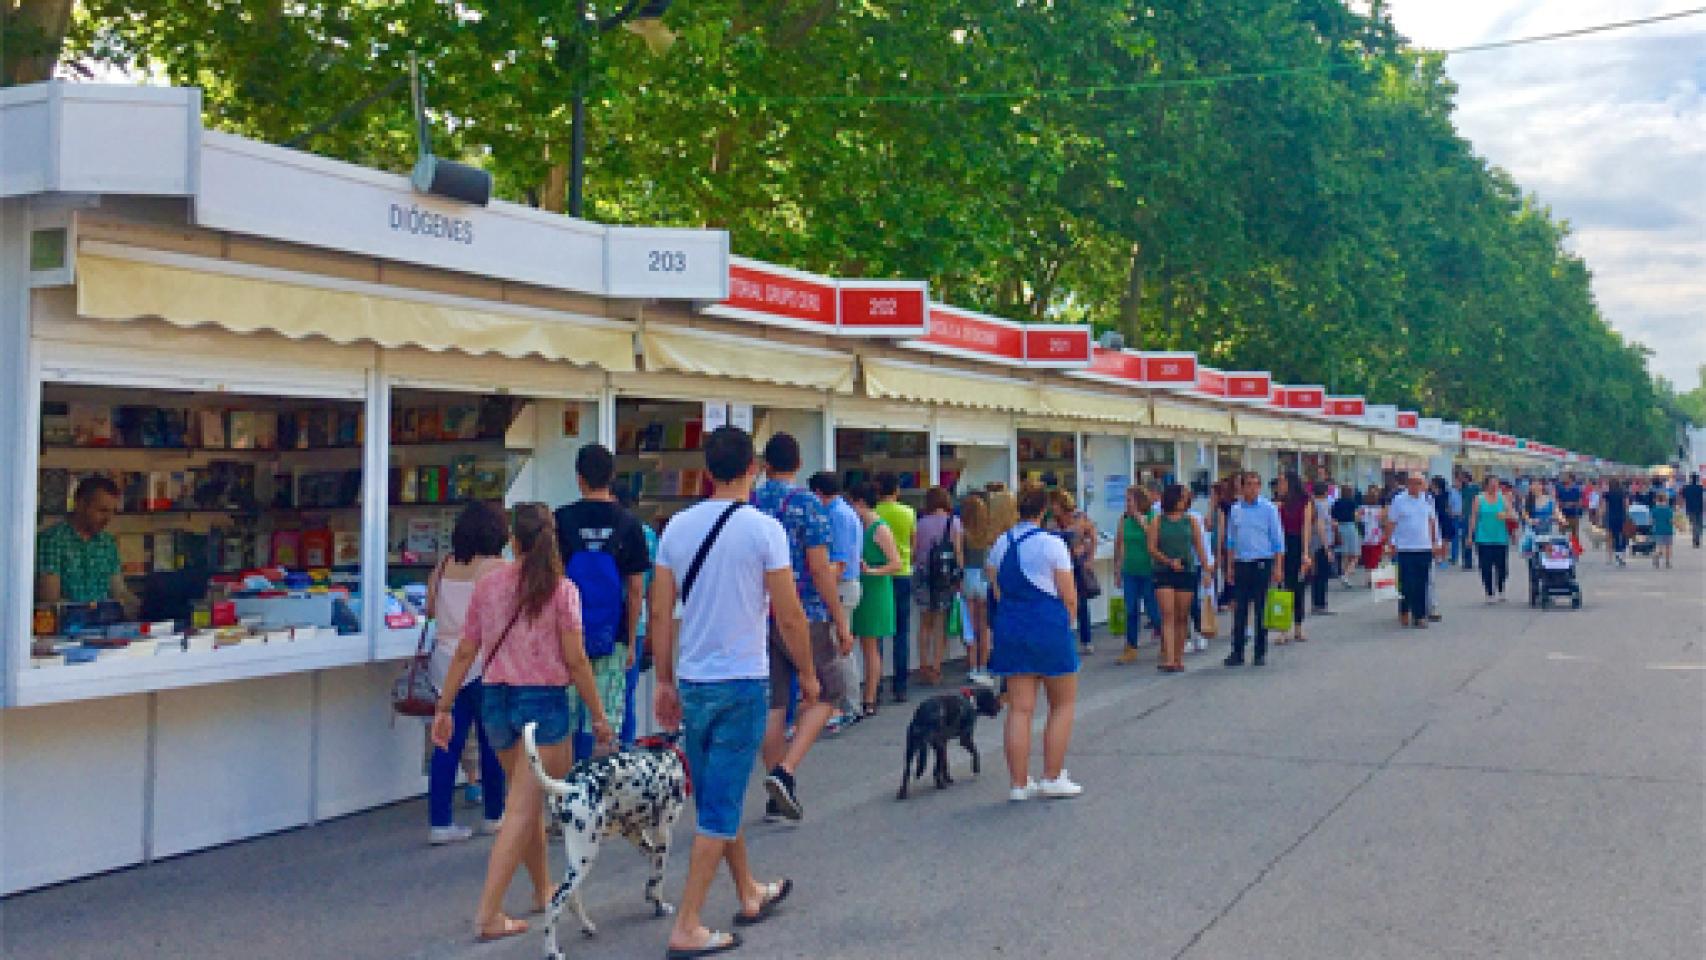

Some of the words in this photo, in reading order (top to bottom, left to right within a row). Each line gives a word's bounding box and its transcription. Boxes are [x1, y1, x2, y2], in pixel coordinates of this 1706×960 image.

[390, 203, 473, 244] DIÓGENES
[648, 250, 686, 271] 203
[869, 297, 897, 315] 202
